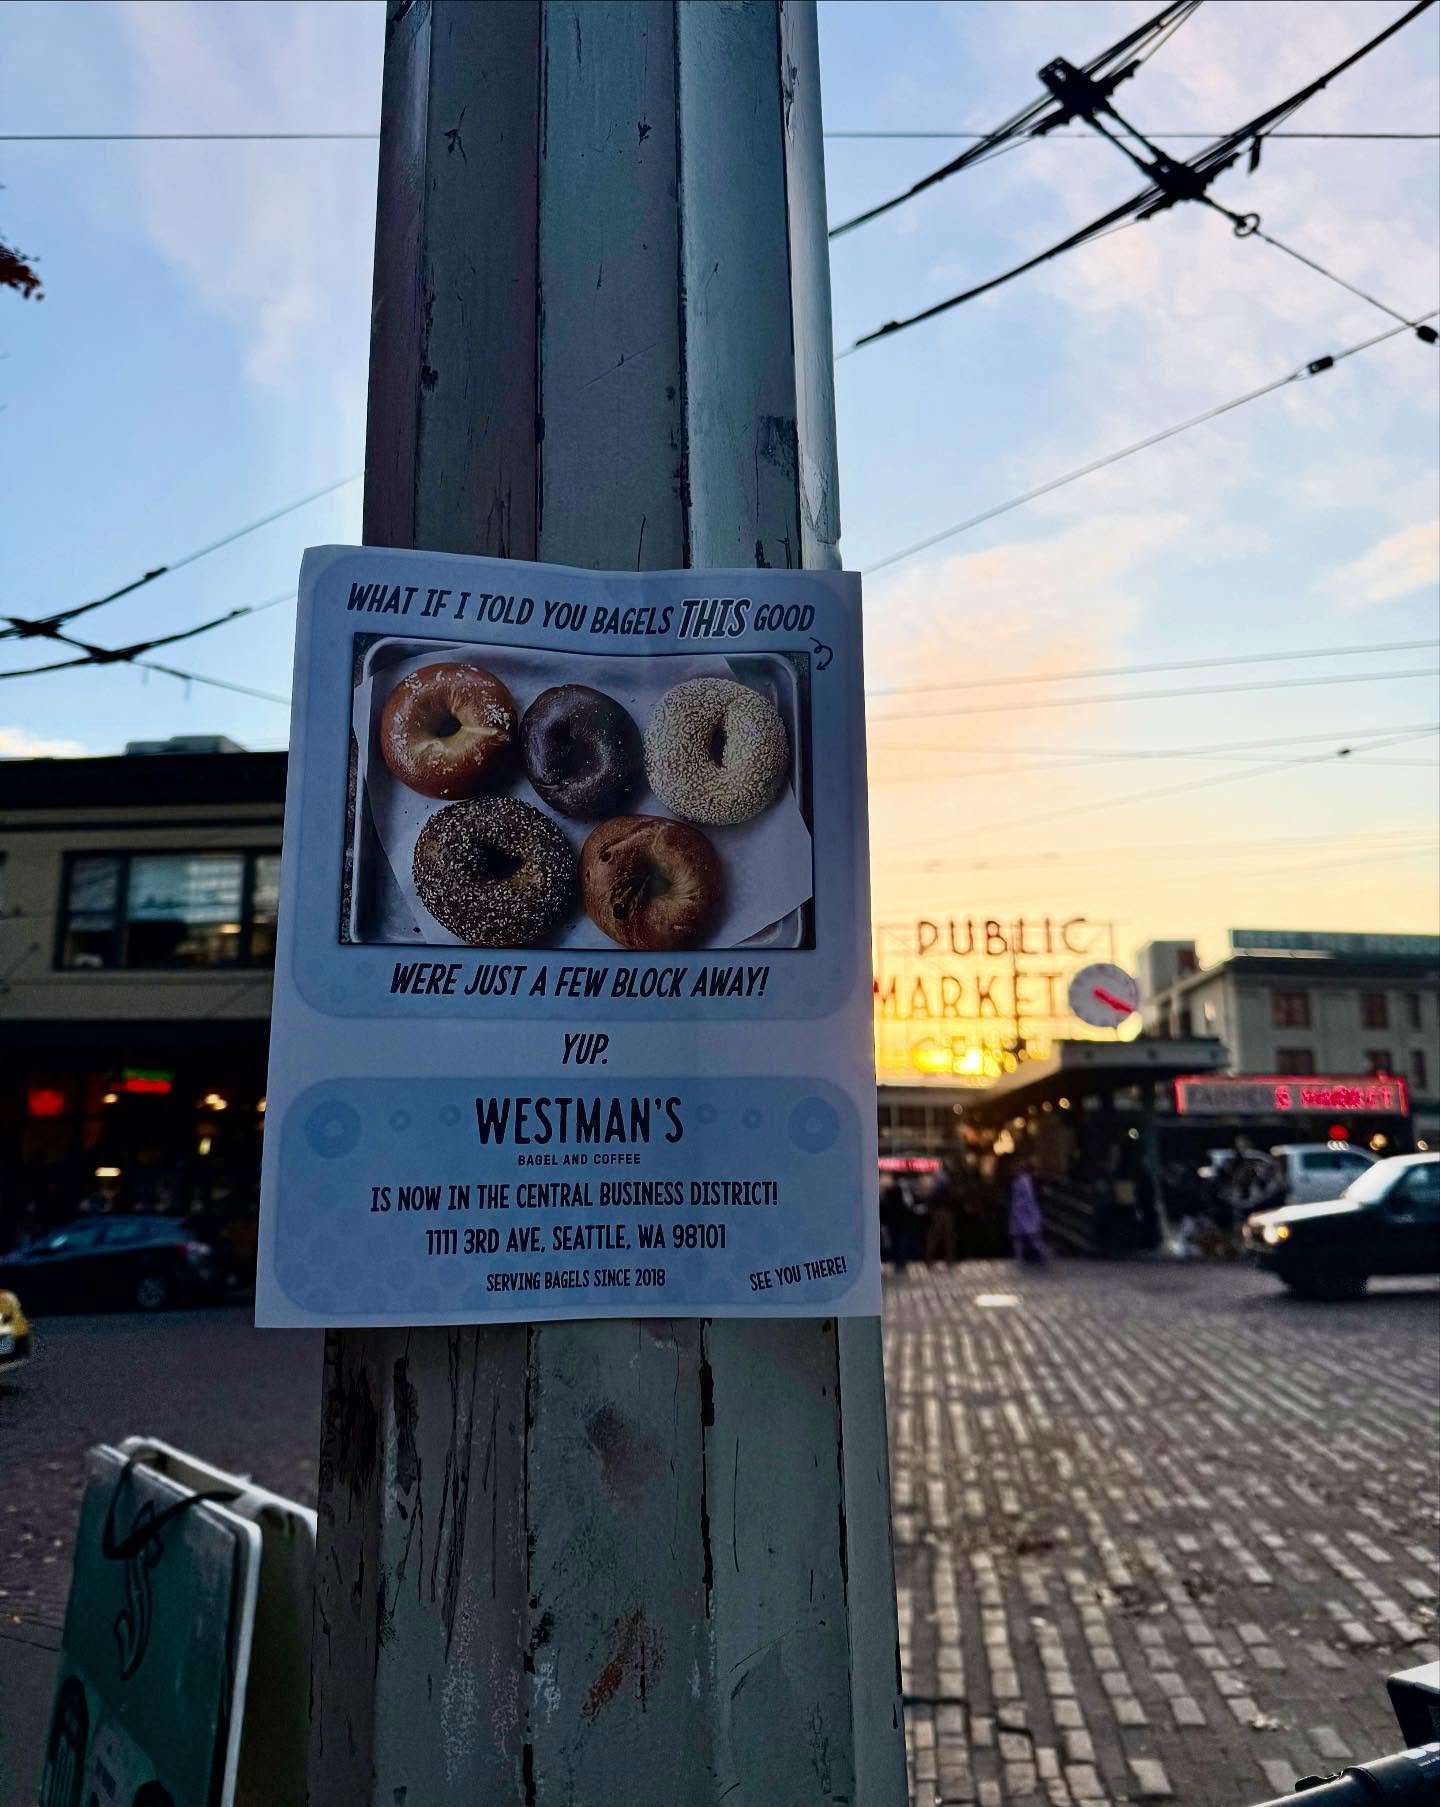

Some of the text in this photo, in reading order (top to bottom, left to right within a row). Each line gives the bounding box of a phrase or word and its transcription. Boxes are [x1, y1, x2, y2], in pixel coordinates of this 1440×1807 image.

[346, 582, 816, 641] WHAT IF I TOLD YOU BAGELS THIS GOOD
[917, 917, 1089, 956] PUBLIC
[389, 962, 771, 998] WERE JUST A FEW BLOCK AWAY!
[872, 973, 1062, 1018] MARKET
[562, 1033, 610, 1065] YUP.
[475, 1096, 684, 1145] WESTMAN'S
[517, 1153, 641, 1167] BAGEL AND COFFEE
[370, 1180, 778, 1213] IS NOW IN THE CENTRAL BUSINESS DISTRICT!
[425, 1223, 726, 1256] 1111 3RD AVE, SEATTLE, WA 98101
[486, 1268, 666, 1292] SERVING BAGELS SINCE 2018
[749, 1255, 848, 1292] SEE YOU THERE!
